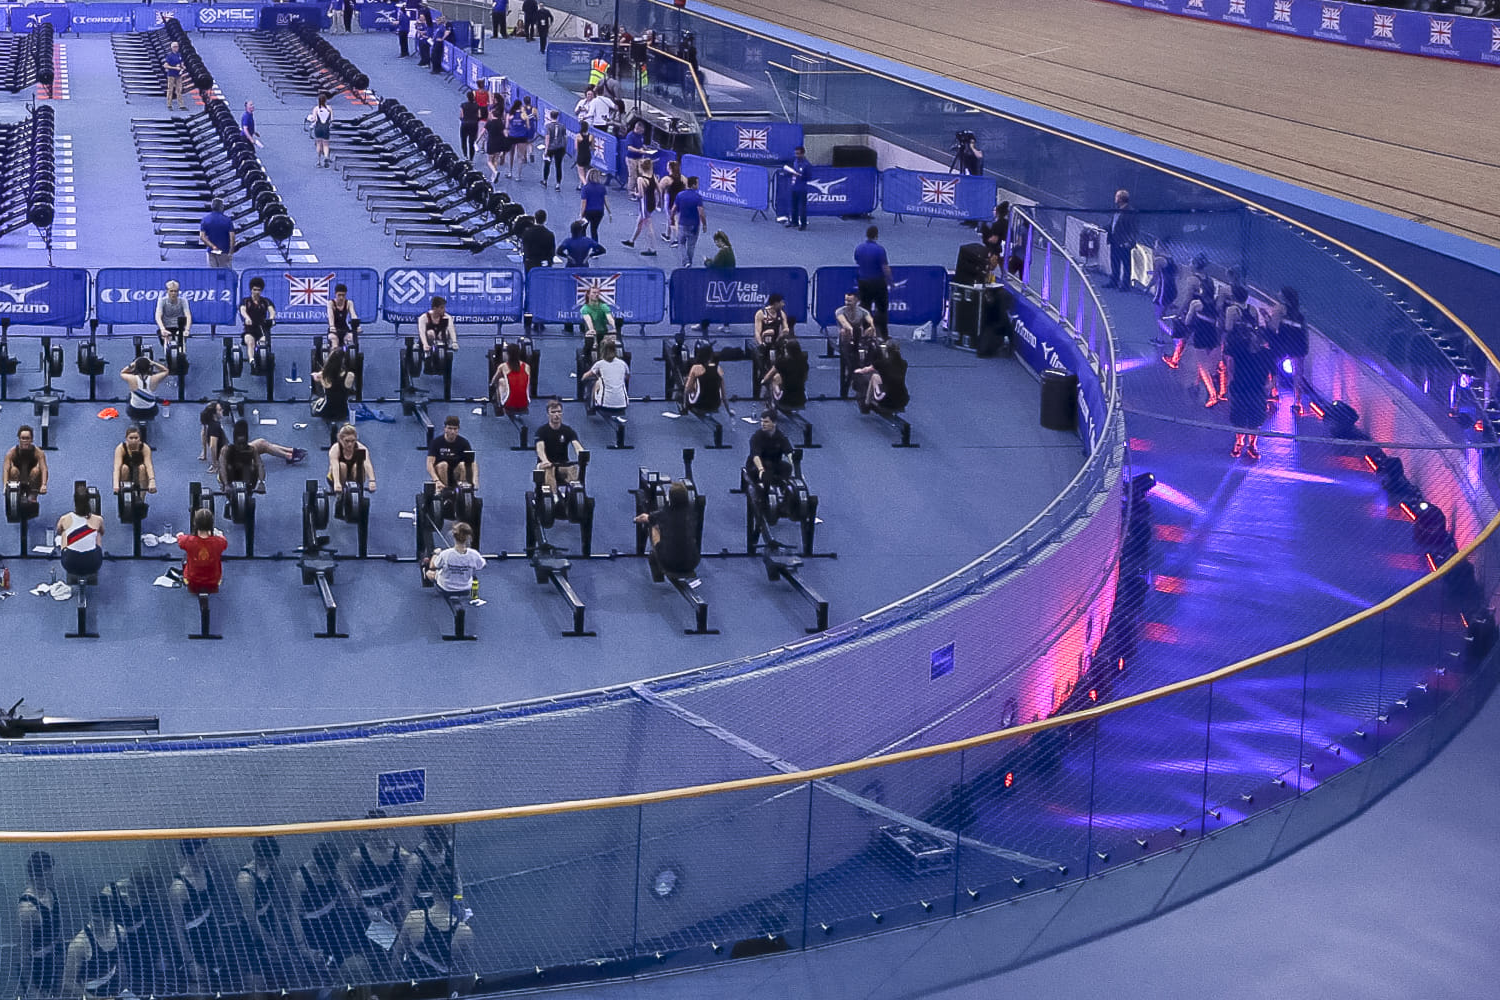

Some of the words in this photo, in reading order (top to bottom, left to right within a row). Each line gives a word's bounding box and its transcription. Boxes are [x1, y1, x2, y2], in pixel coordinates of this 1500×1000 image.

[217, 8, 254, 19] MSC
[428, 271, 512, 294] MSC
[737, 281, 758, 292] Lee
[221, 289, 231, 301] 2
[736, 292, 770, 304] Valley
